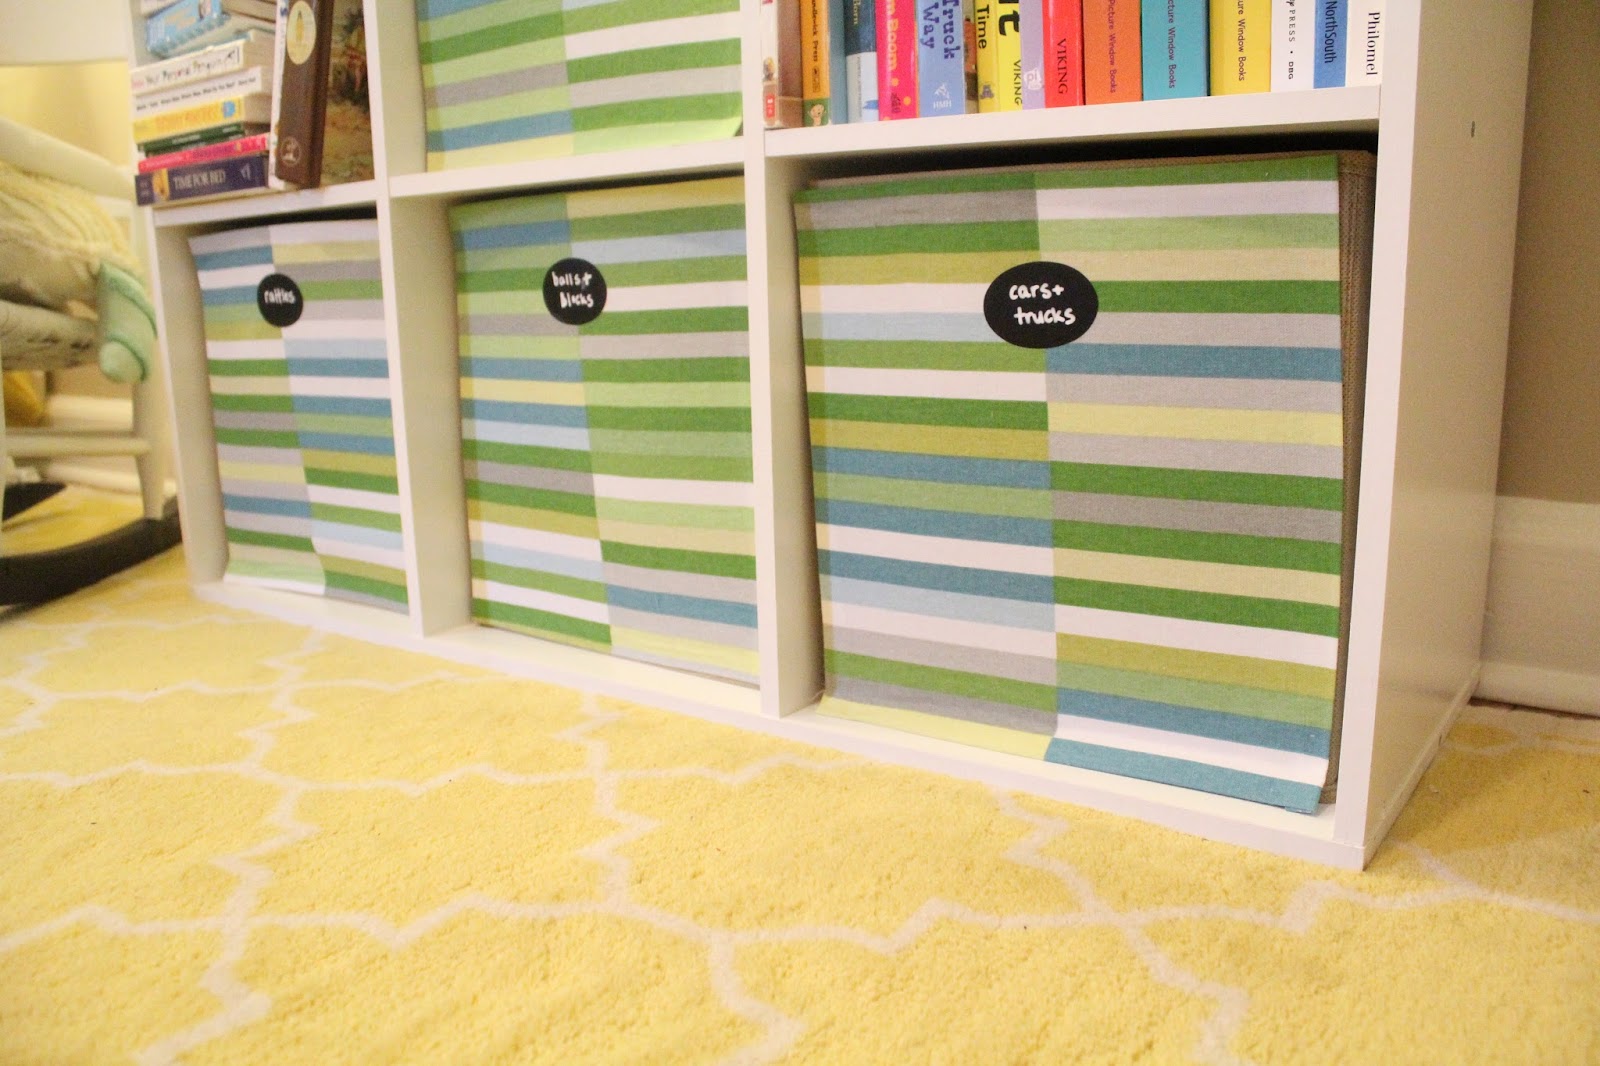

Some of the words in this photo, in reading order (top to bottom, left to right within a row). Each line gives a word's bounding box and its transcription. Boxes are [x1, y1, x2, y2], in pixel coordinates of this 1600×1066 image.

[920, 2, 940, 49] Way
[977, 4, 990, 49] Time
[1237, 18, 1246, 53] Window
[1288, 9, 1296, 42] PRESS
[1324, 0, 1339, 64] NorthSouth
[1108, 33, 1116, 66] Window
[1167, 27, 1176, 61] Window
[1366, 12, 1381, 76] Philomel
[1013, 59, 1023, 106] VIKING
[1057, 38, 1068, 95] VIKING
[1109, 69, 1118, 94] Books
[1168, 64, 1177, 89] Books
[1238, 56, 1247, 82] Books
[933, 99, 952, 109] HMH
[1013, 306, 1077, 325] trucks
